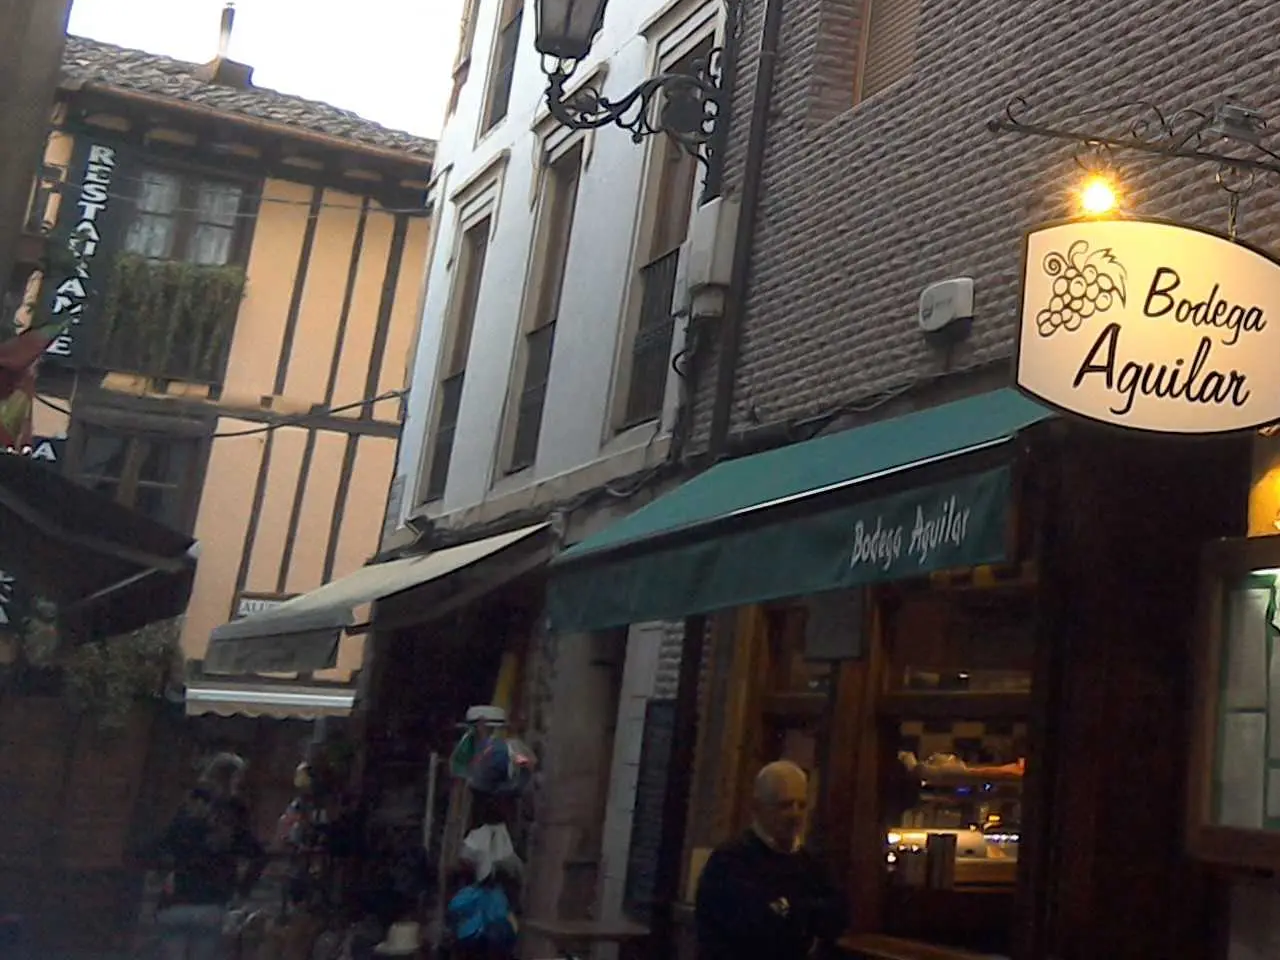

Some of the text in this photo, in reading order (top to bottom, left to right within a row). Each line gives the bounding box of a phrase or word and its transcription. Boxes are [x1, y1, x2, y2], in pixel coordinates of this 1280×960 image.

[1143, 266, 1267, 346] Bodega
[1072, 322, 1250, 416] Aguilar
[850, 494, 971, 572] Bodega Aguilar
